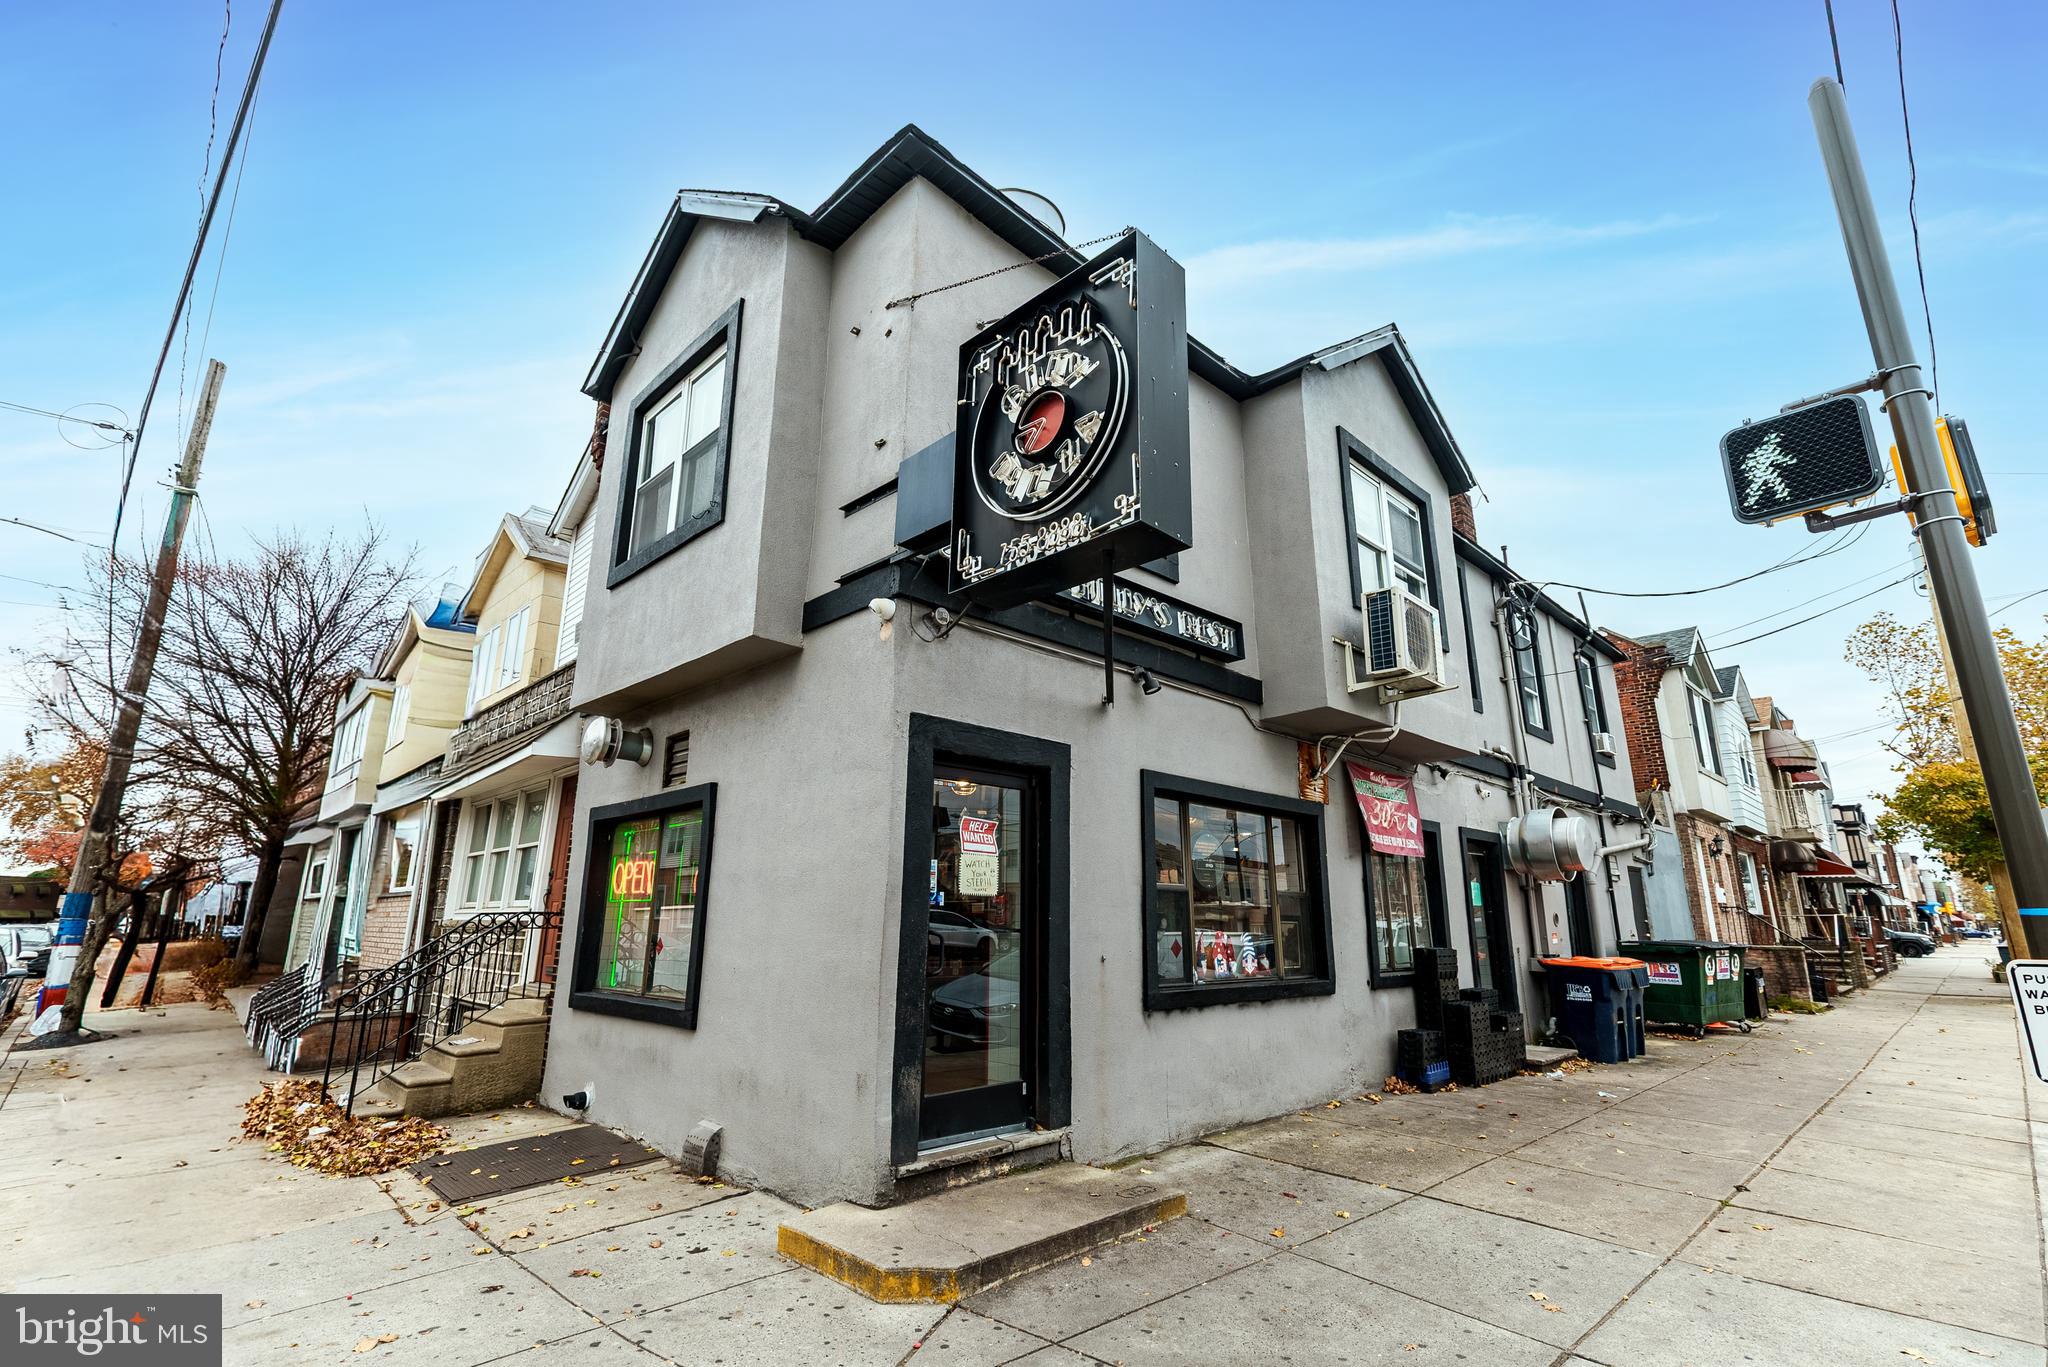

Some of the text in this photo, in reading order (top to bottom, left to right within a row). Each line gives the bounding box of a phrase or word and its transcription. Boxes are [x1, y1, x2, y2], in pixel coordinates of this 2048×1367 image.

[969, 821, 989, 833] HELP
[962, 831, 994, 844] WANTED
[965, 860, 991, 868] WATCH
[612, 860, 655, 895] OPEN
[2023, 974, 2048, 984] PU
[2034, 1004, 2048, 1014] B
